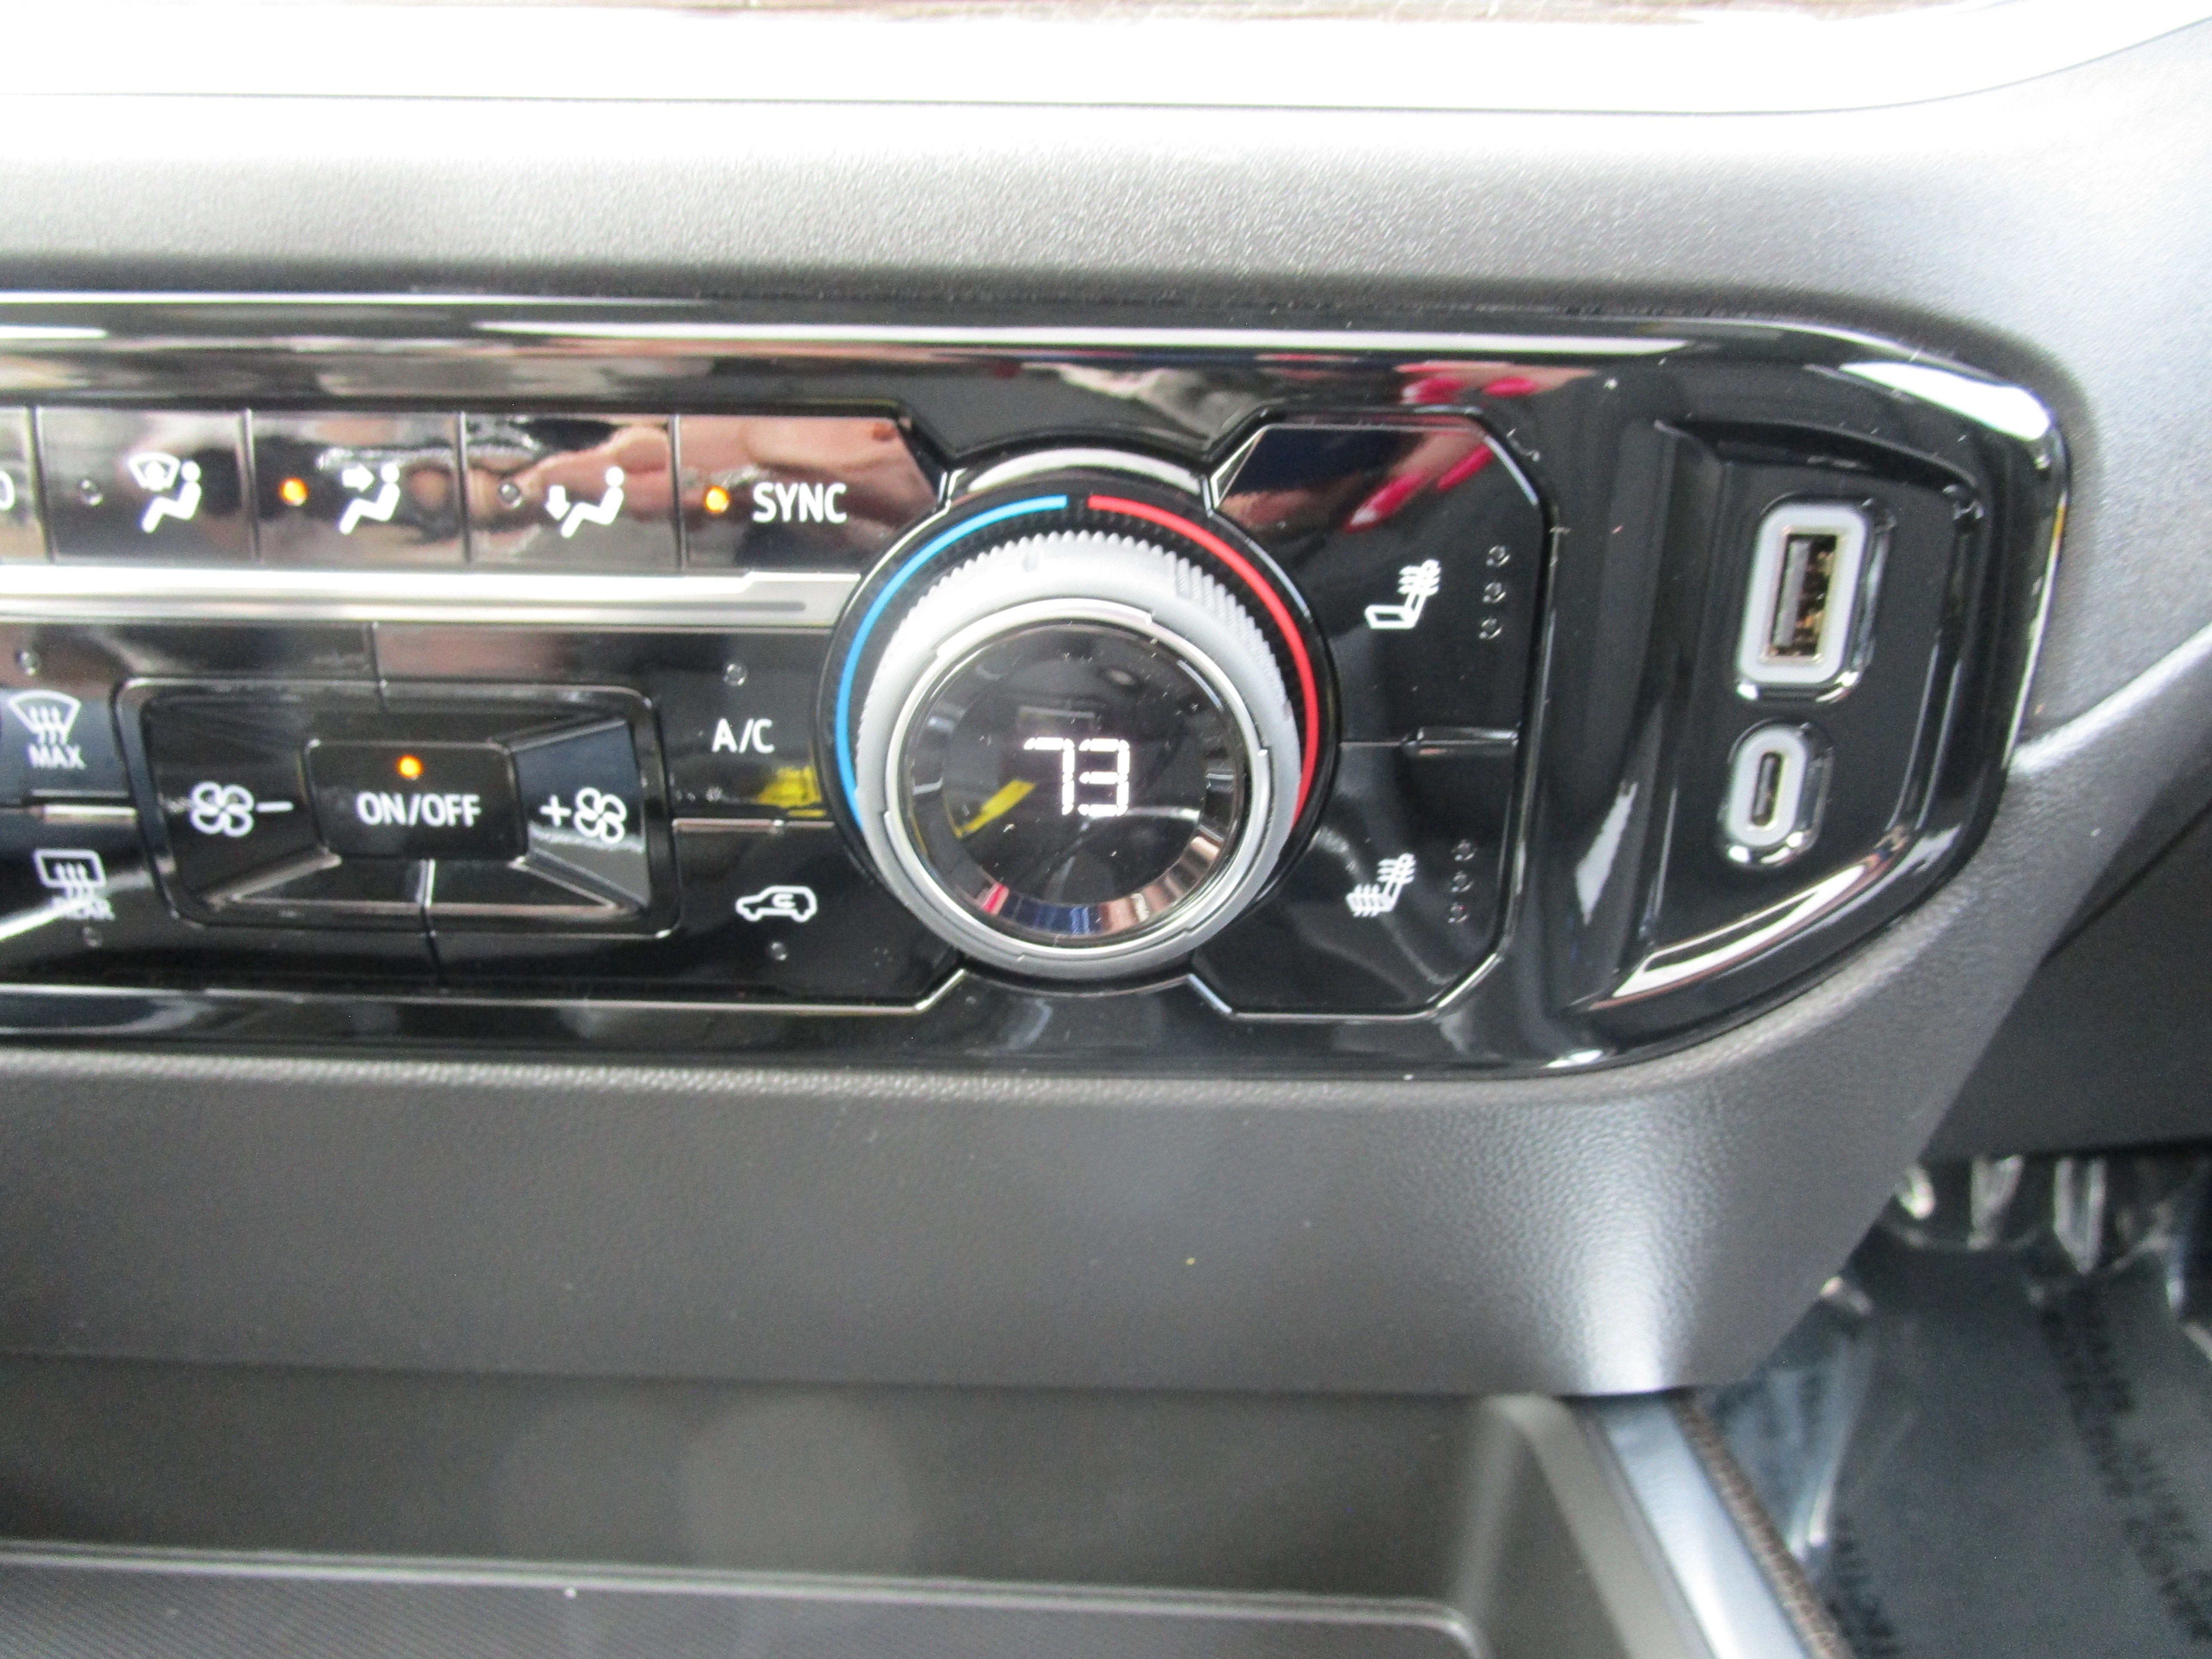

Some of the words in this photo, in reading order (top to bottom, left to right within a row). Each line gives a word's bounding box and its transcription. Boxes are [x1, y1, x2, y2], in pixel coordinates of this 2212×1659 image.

[752, 482, 848, 523] SYNC
[711, 718, 775, 753] A/C
[27, 744, 86, 769] MAX
[1024, 737, 1130, 816] 73
[356, 792, 481, 826] ON/OFF
